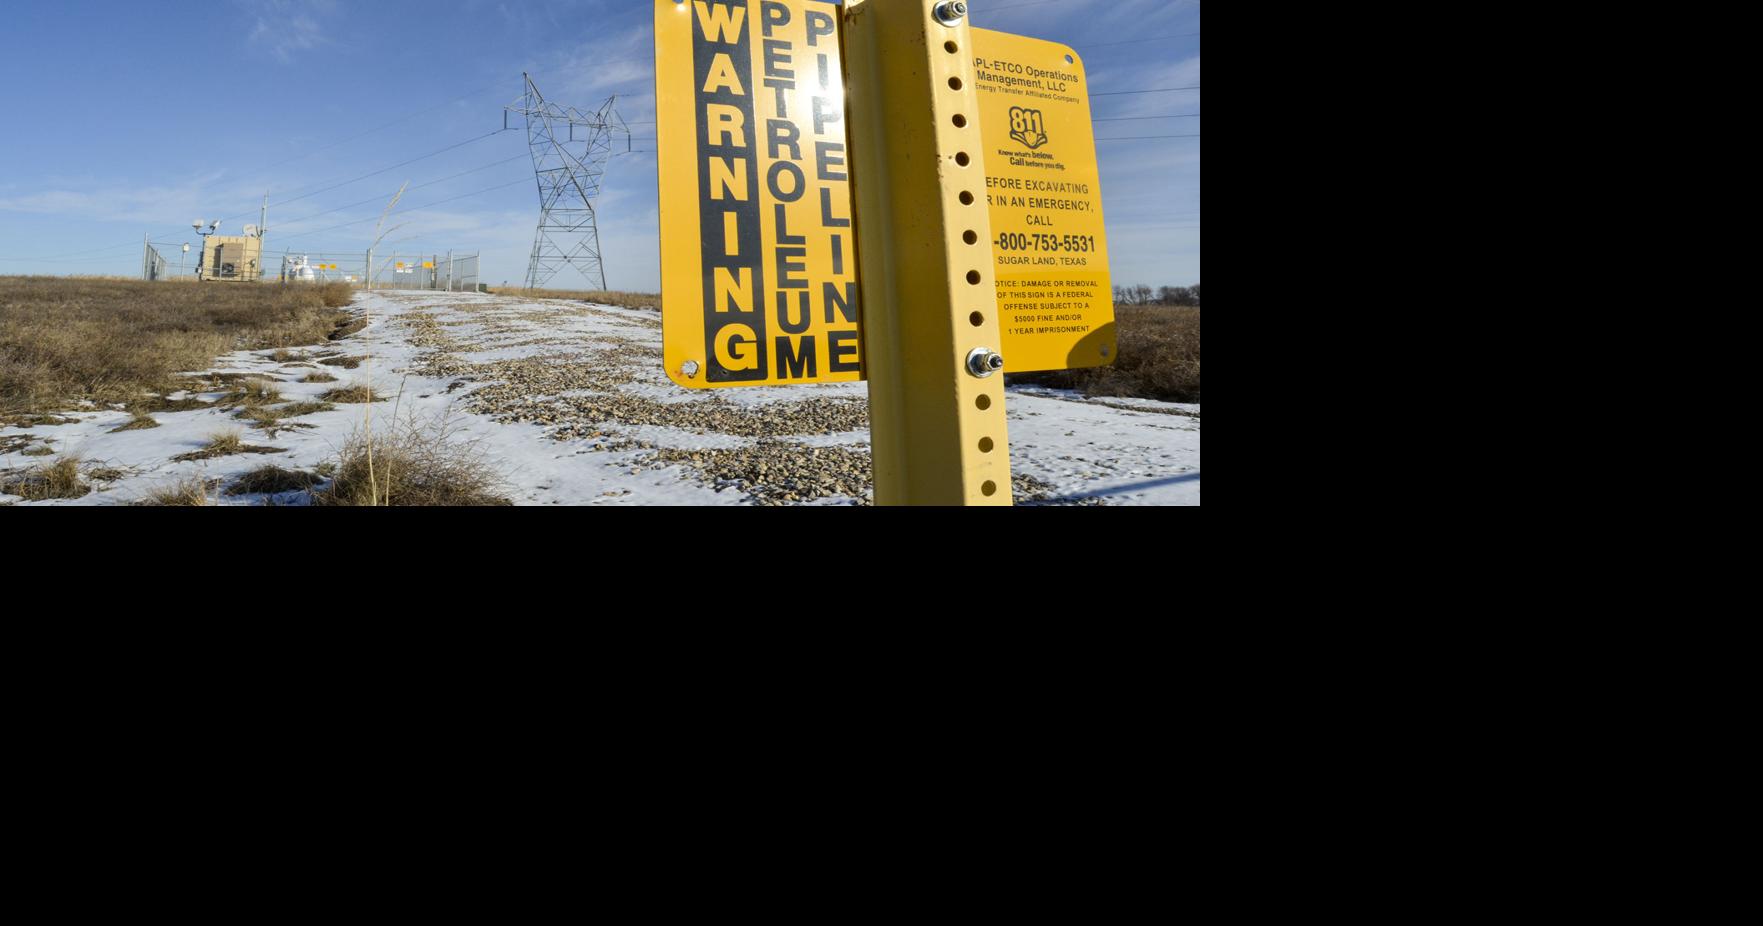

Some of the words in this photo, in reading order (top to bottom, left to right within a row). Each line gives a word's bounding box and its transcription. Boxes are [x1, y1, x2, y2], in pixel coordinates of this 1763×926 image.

[973, 58, 1022, 74] PL-ETCO
[1026, 66, 1078, 82] Operations
[977, 70, 1045, 90] Management,
[1047, 82, 1066, 92] LLC
[975, 83, 996, 92] Energy
[998, 86, 1024, 95] Transfer
[1025, 90, 1052, 99] Affiliated
[1053, 94, 1080, 104] Company
[1009, 106, 1042, 133] 811
[1010, 157, 1025, 166] Call
[1025, 160, 1044, 168] before
[1055, 163, 1066, 171] dig.
[1031, 151, 1054, 160] below.
[694, 0, 758, 371] WARNING
[760, 0, 817, 379] PETROLEUM
[805, 10, 860, 372] PIPELINE
[985, 176, 1022, 189] EFORE
[1025, 180, 1089, 194] EXCAVATING
[996, 195, 1007, 206] IN
[1011, 196, 1025, 207] AN
[1029, 197, 1094, 213] EMERGENCY,
[1026, 214, 1053, 226] CALL
[993, 232, 1095, 252] -800-753-5531
[998, 256, 1030, 265] SUGAR
[1032, 257, 1058, 266] LAND,
[1060, 257, 1087, 266] TEXAS
[995, 280, 1019, 288] OTICE:
[996, 291, 1007, 299] OF
[1040, 302, 1071, 310] SUBJECT
[1014, 315, 1035, 323] $5000
[1037, 314, 1054, 322] FINE
[1014, 327, 1034, 335] YEAR
[1036, 325, 1090, 334] IMPRISONMENT
